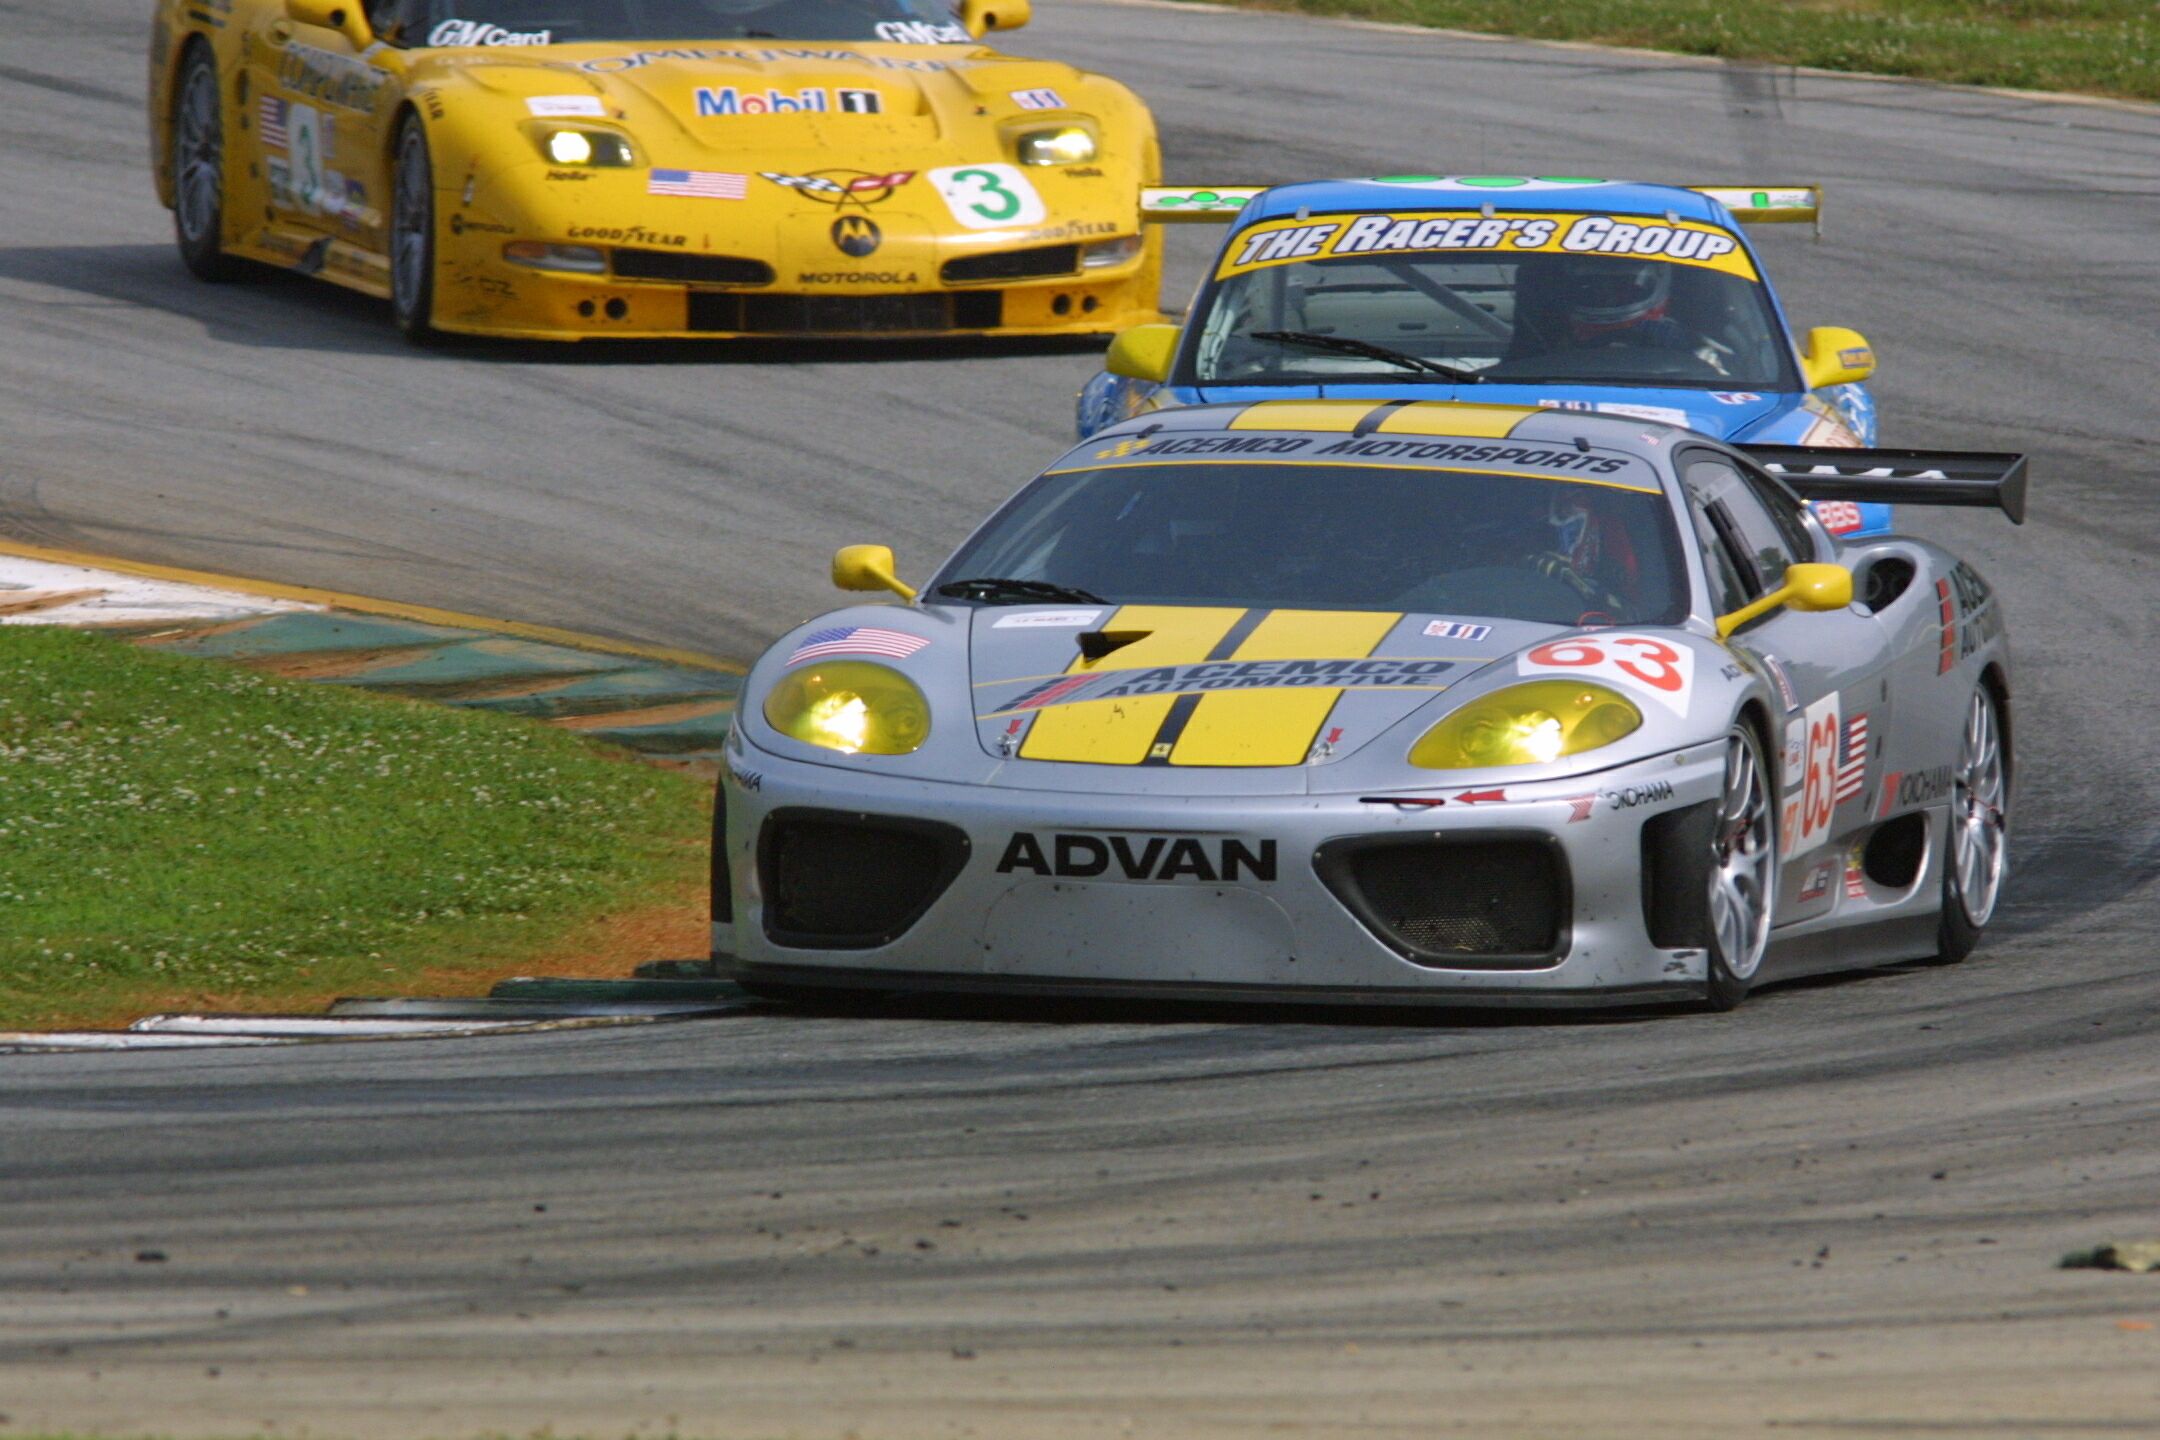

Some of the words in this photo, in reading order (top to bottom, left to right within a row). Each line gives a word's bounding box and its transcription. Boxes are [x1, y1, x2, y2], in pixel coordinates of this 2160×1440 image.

[695, 88, 825, 115] Mobil
[952, 169, 1021, 221] 3
[1233, 223, 1341, 267] THE
[1331, 214, 1558, 254] RACER'S
[1559, 215, 1736, 261] GROUP
[797, 271, 918, 284] MOTOROLA
[1133, 437, 1313, 456] ACEMCO
[1313, 438, 1630, 474] MOTORSPORTS
[1098, 674, 1438, 698] AUTOMOTIVE
[1128, 660, 1456, 684] ACEMCO
[1527, 637, 1684, 692] 63
[1802, 712, 1838, 839] 63
[996, 832, 1277, 881] ADVAN
